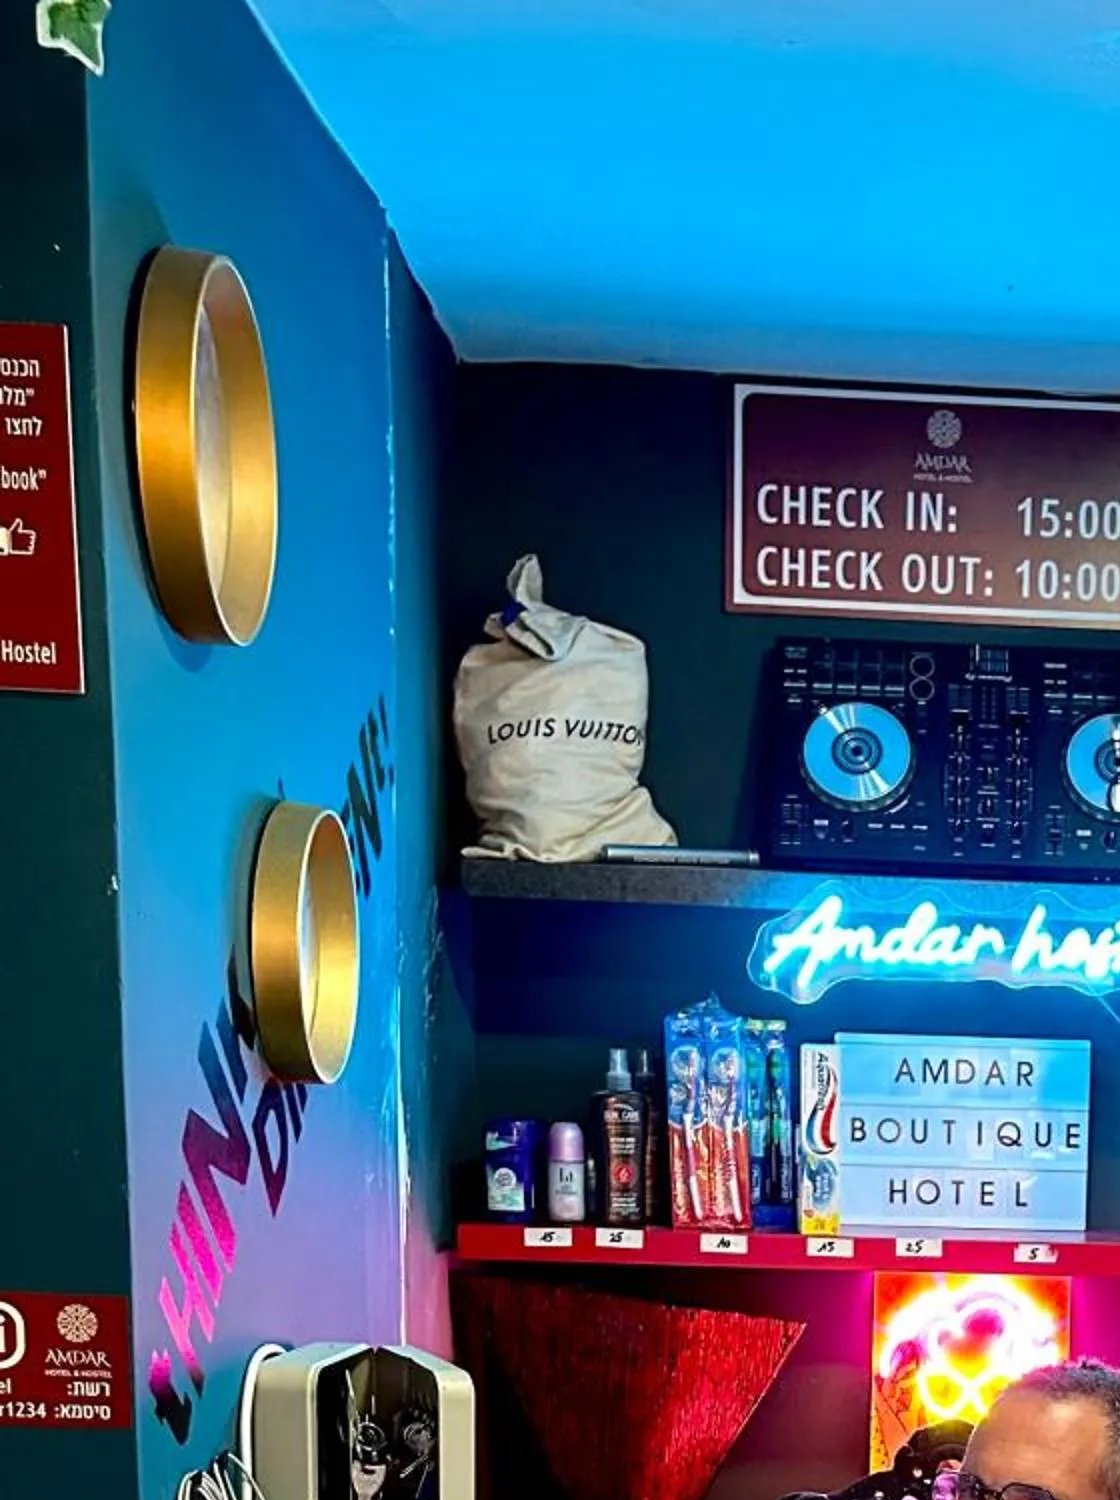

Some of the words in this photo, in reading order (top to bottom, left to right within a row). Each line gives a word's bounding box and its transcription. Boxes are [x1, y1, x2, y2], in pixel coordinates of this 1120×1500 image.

[757, 483, 885, 530] CHECK
[905, 490, 958, 533] IN:
[756, 545, 884, 592] CHECK
[902, 552, 994, 597] OUT:
[1, 640, 57, 665] Hostel
[487, 717, 557, 745] LOUIS
[763, 894, 1006, 992] Amdar
[894, 1058, 1035, 1088] AMDAR
[850, 1116, 1082, 1150] BOUTIQUE
[889, 1178, 1029, 1208] HOTEL
[44, 1348, 112, 1368] AMDAR
